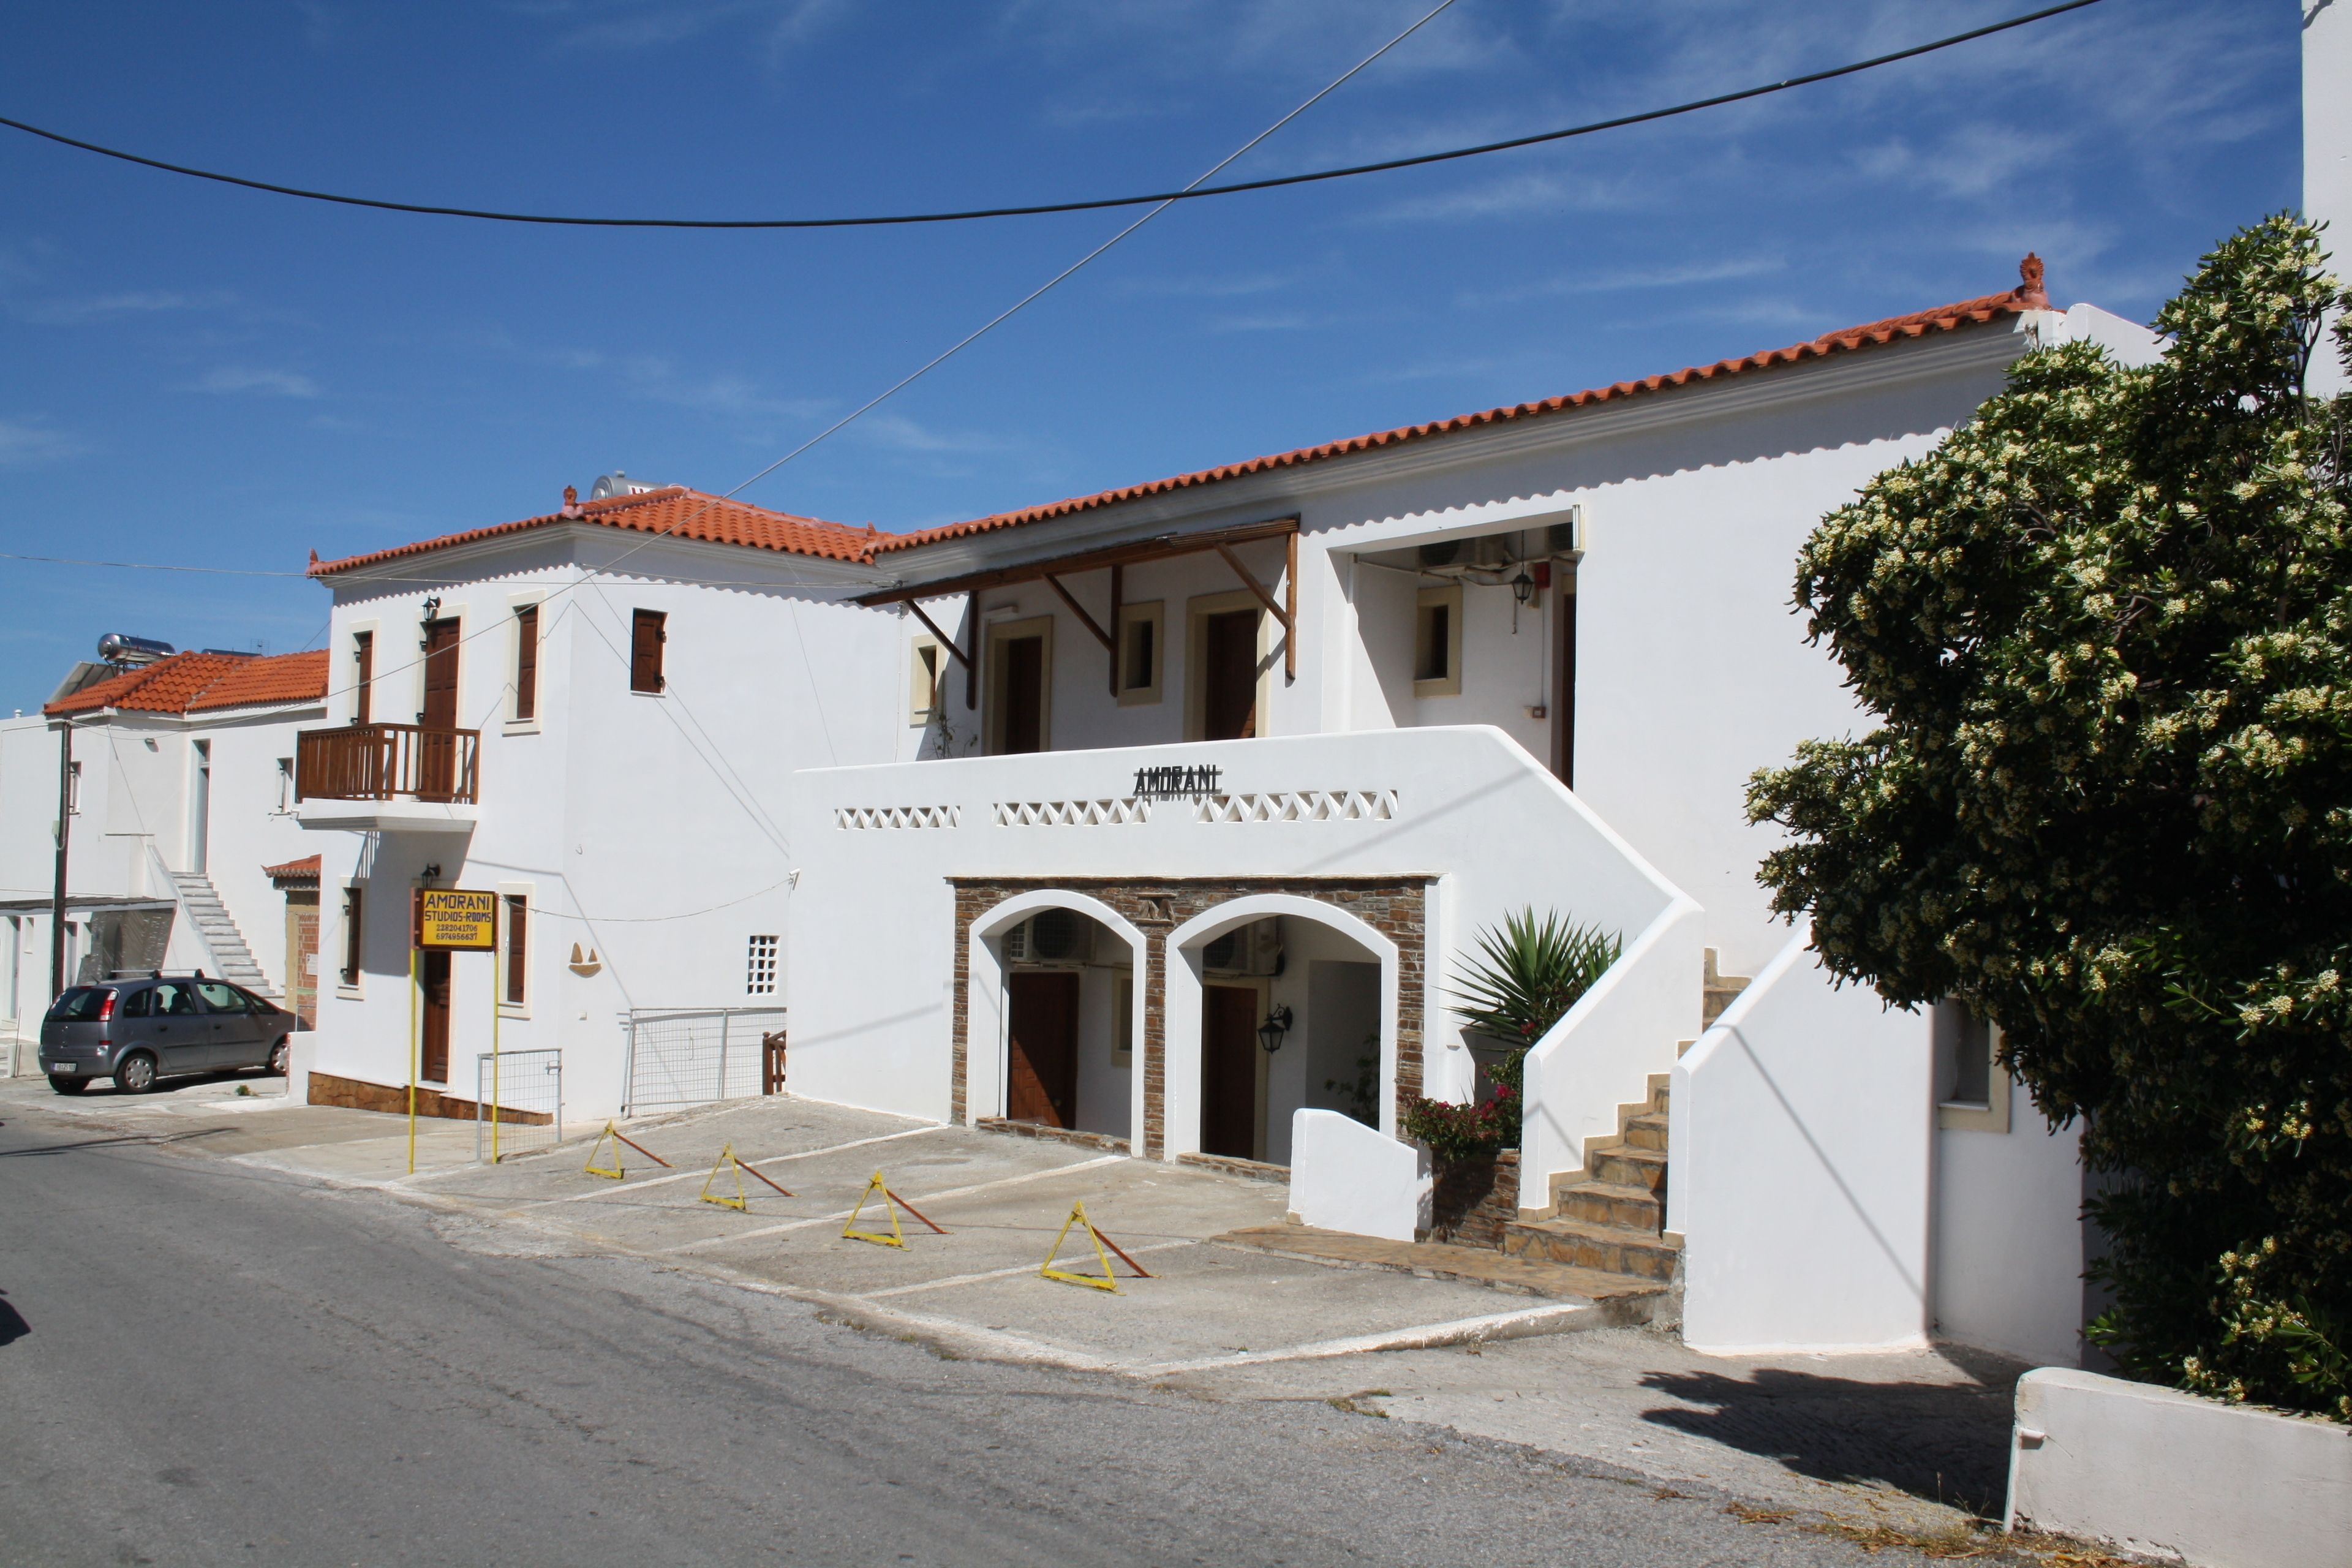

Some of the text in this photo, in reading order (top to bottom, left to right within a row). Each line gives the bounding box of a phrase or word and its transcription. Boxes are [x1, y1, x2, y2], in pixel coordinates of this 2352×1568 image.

[1134, 764, 1216, 794] AMORANI
[424, 894, 489, 910] AMORANI
[424, 910, 491, 922] STUDIOS-ROOMS
